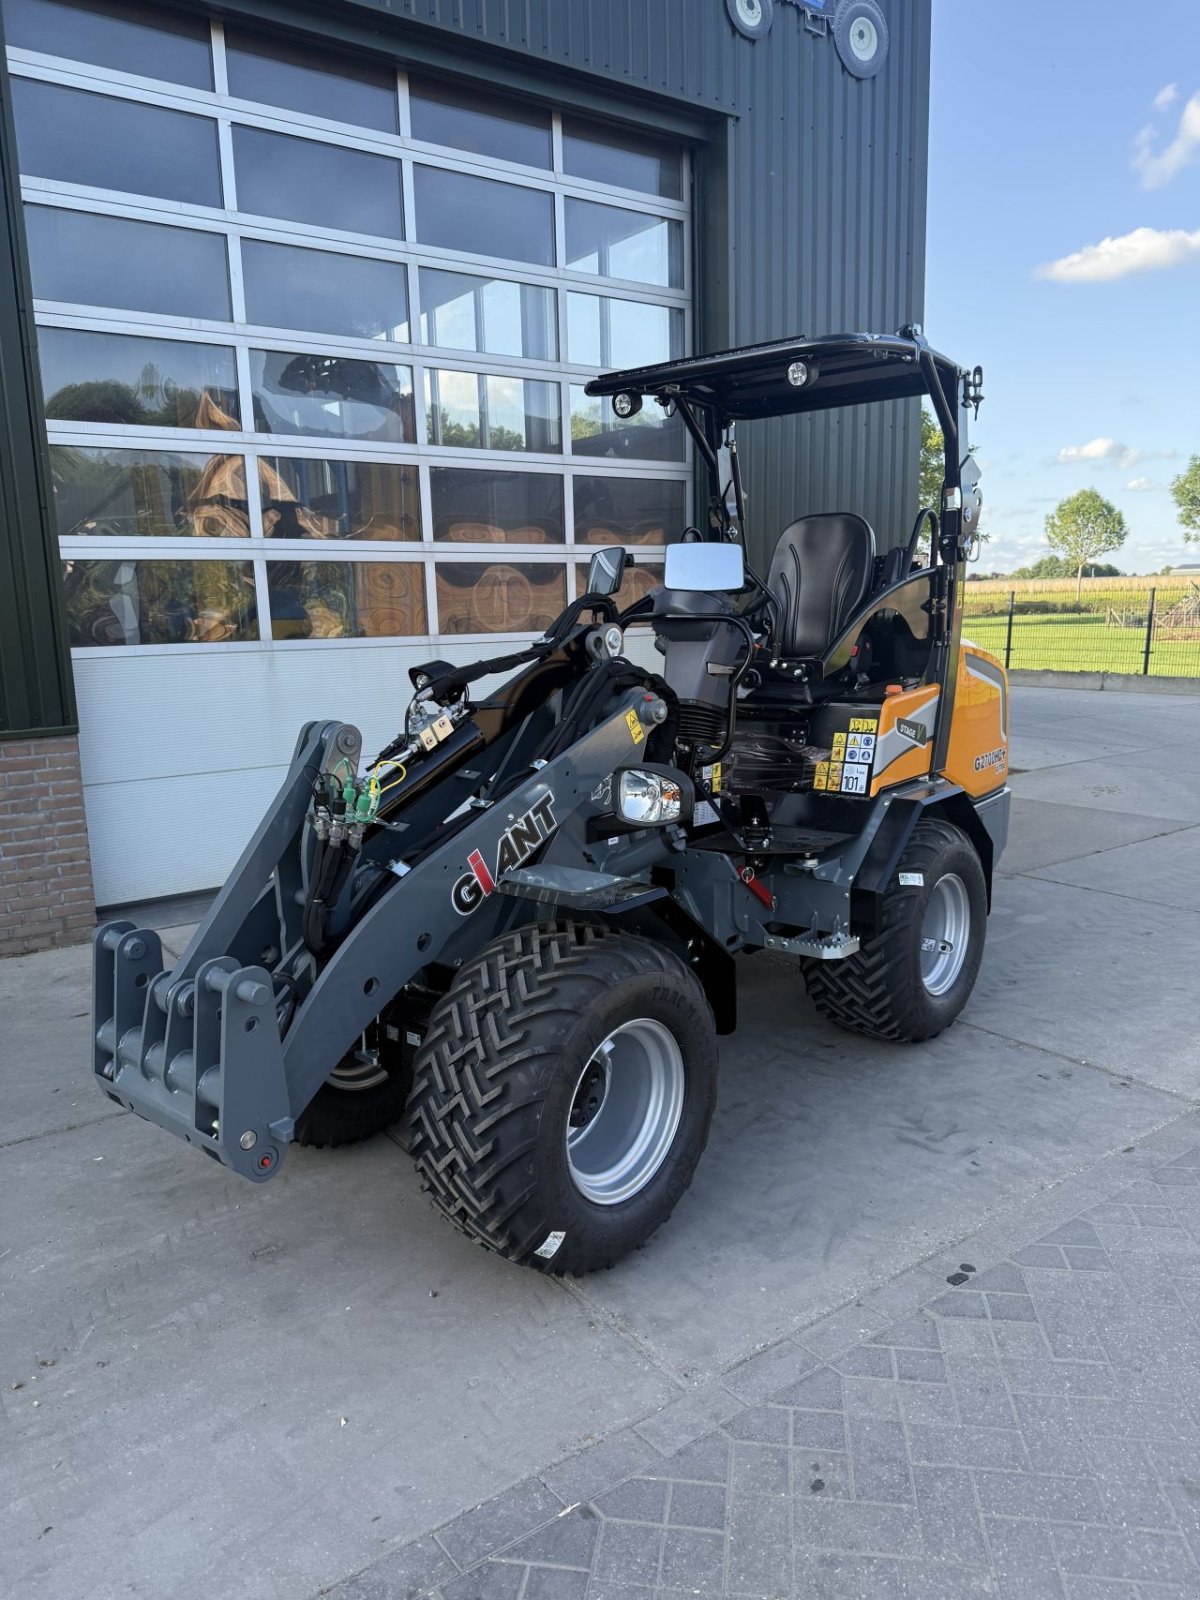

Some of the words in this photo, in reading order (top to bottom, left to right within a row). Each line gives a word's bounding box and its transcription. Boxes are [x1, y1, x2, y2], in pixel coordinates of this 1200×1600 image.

[900, 724, 916, 739] STAGE
[844, 775, 859, 791] 101
[452, 789, 557, 916] GIANT
